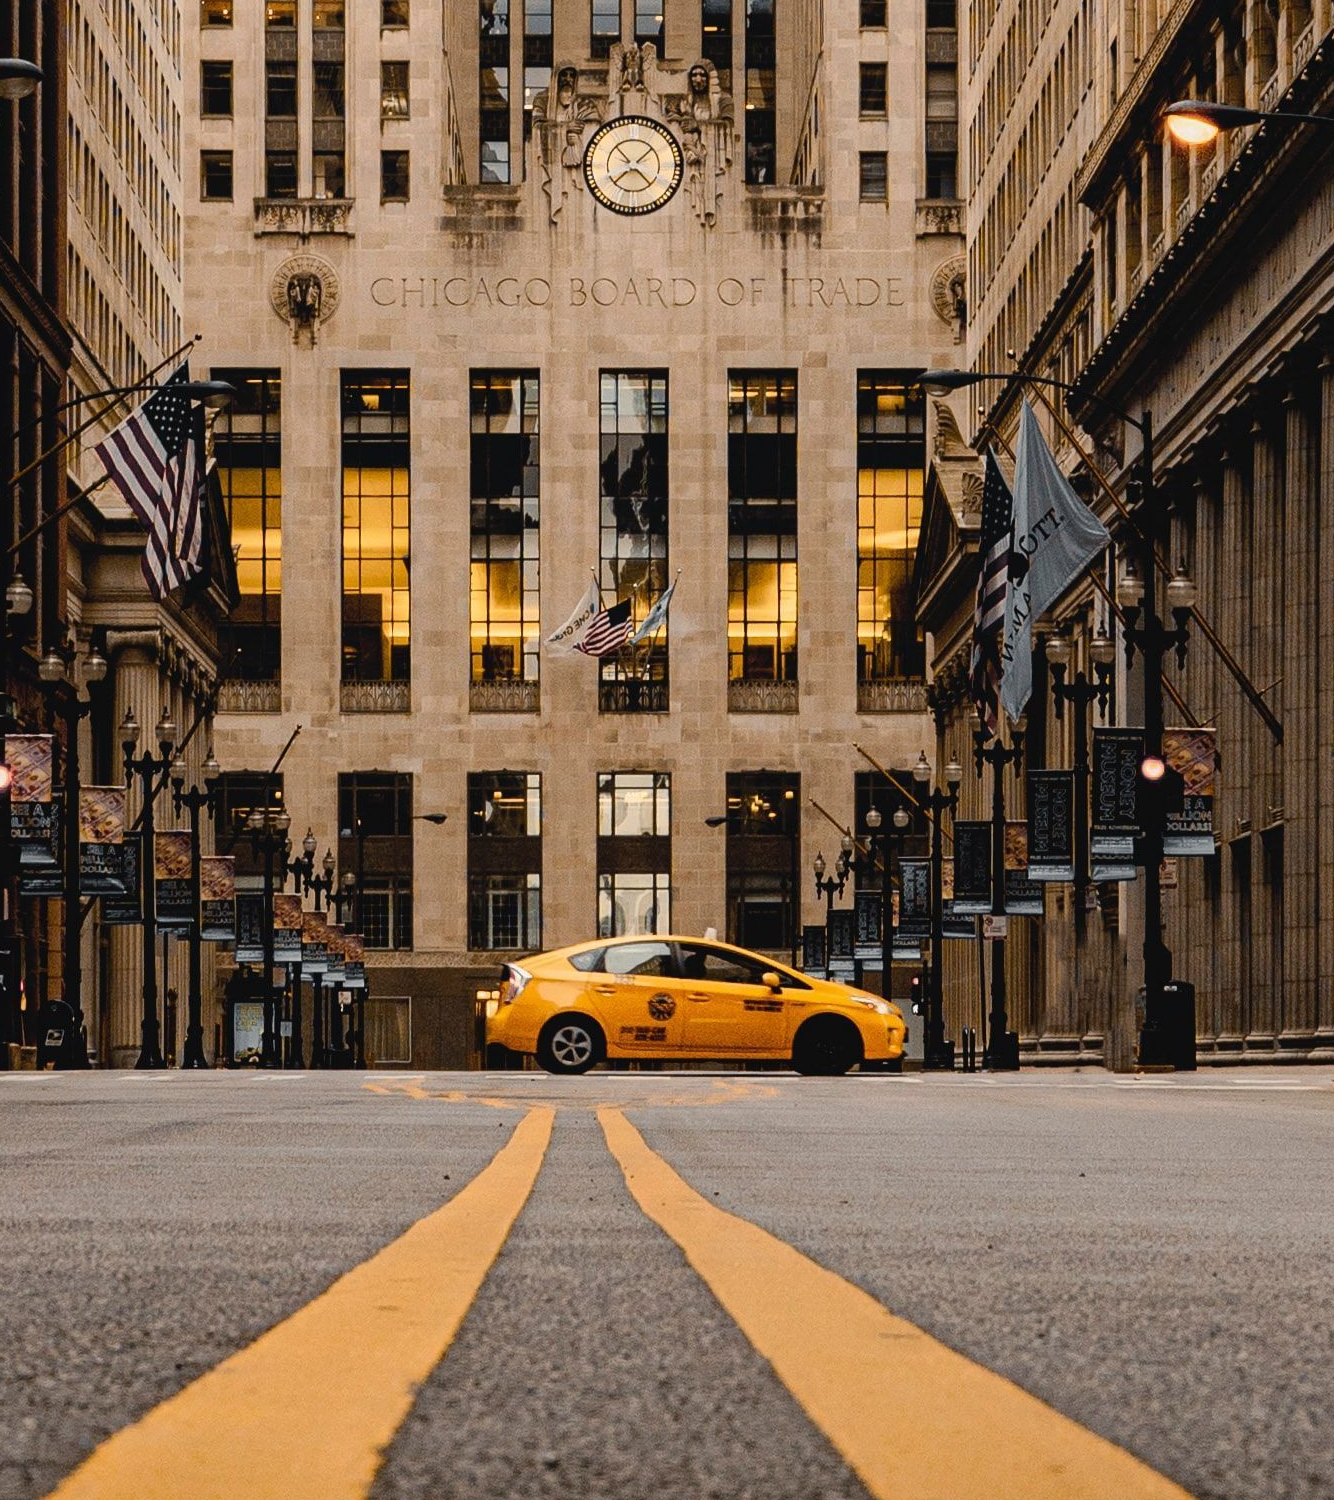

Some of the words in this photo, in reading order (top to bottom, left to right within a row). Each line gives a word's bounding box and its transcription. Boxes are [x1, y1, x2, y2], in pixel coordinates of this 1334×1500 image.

[370, 276, 552, 307] CHICAGO
[570, 276, 696, 307] BOARD
[717, 277, 765, 307] OF
[784, 276, 904, 307] TRADE
[1100, 743, 1117, 821] MUSEUM
[1119, 750, 1137, 820] MONEY
